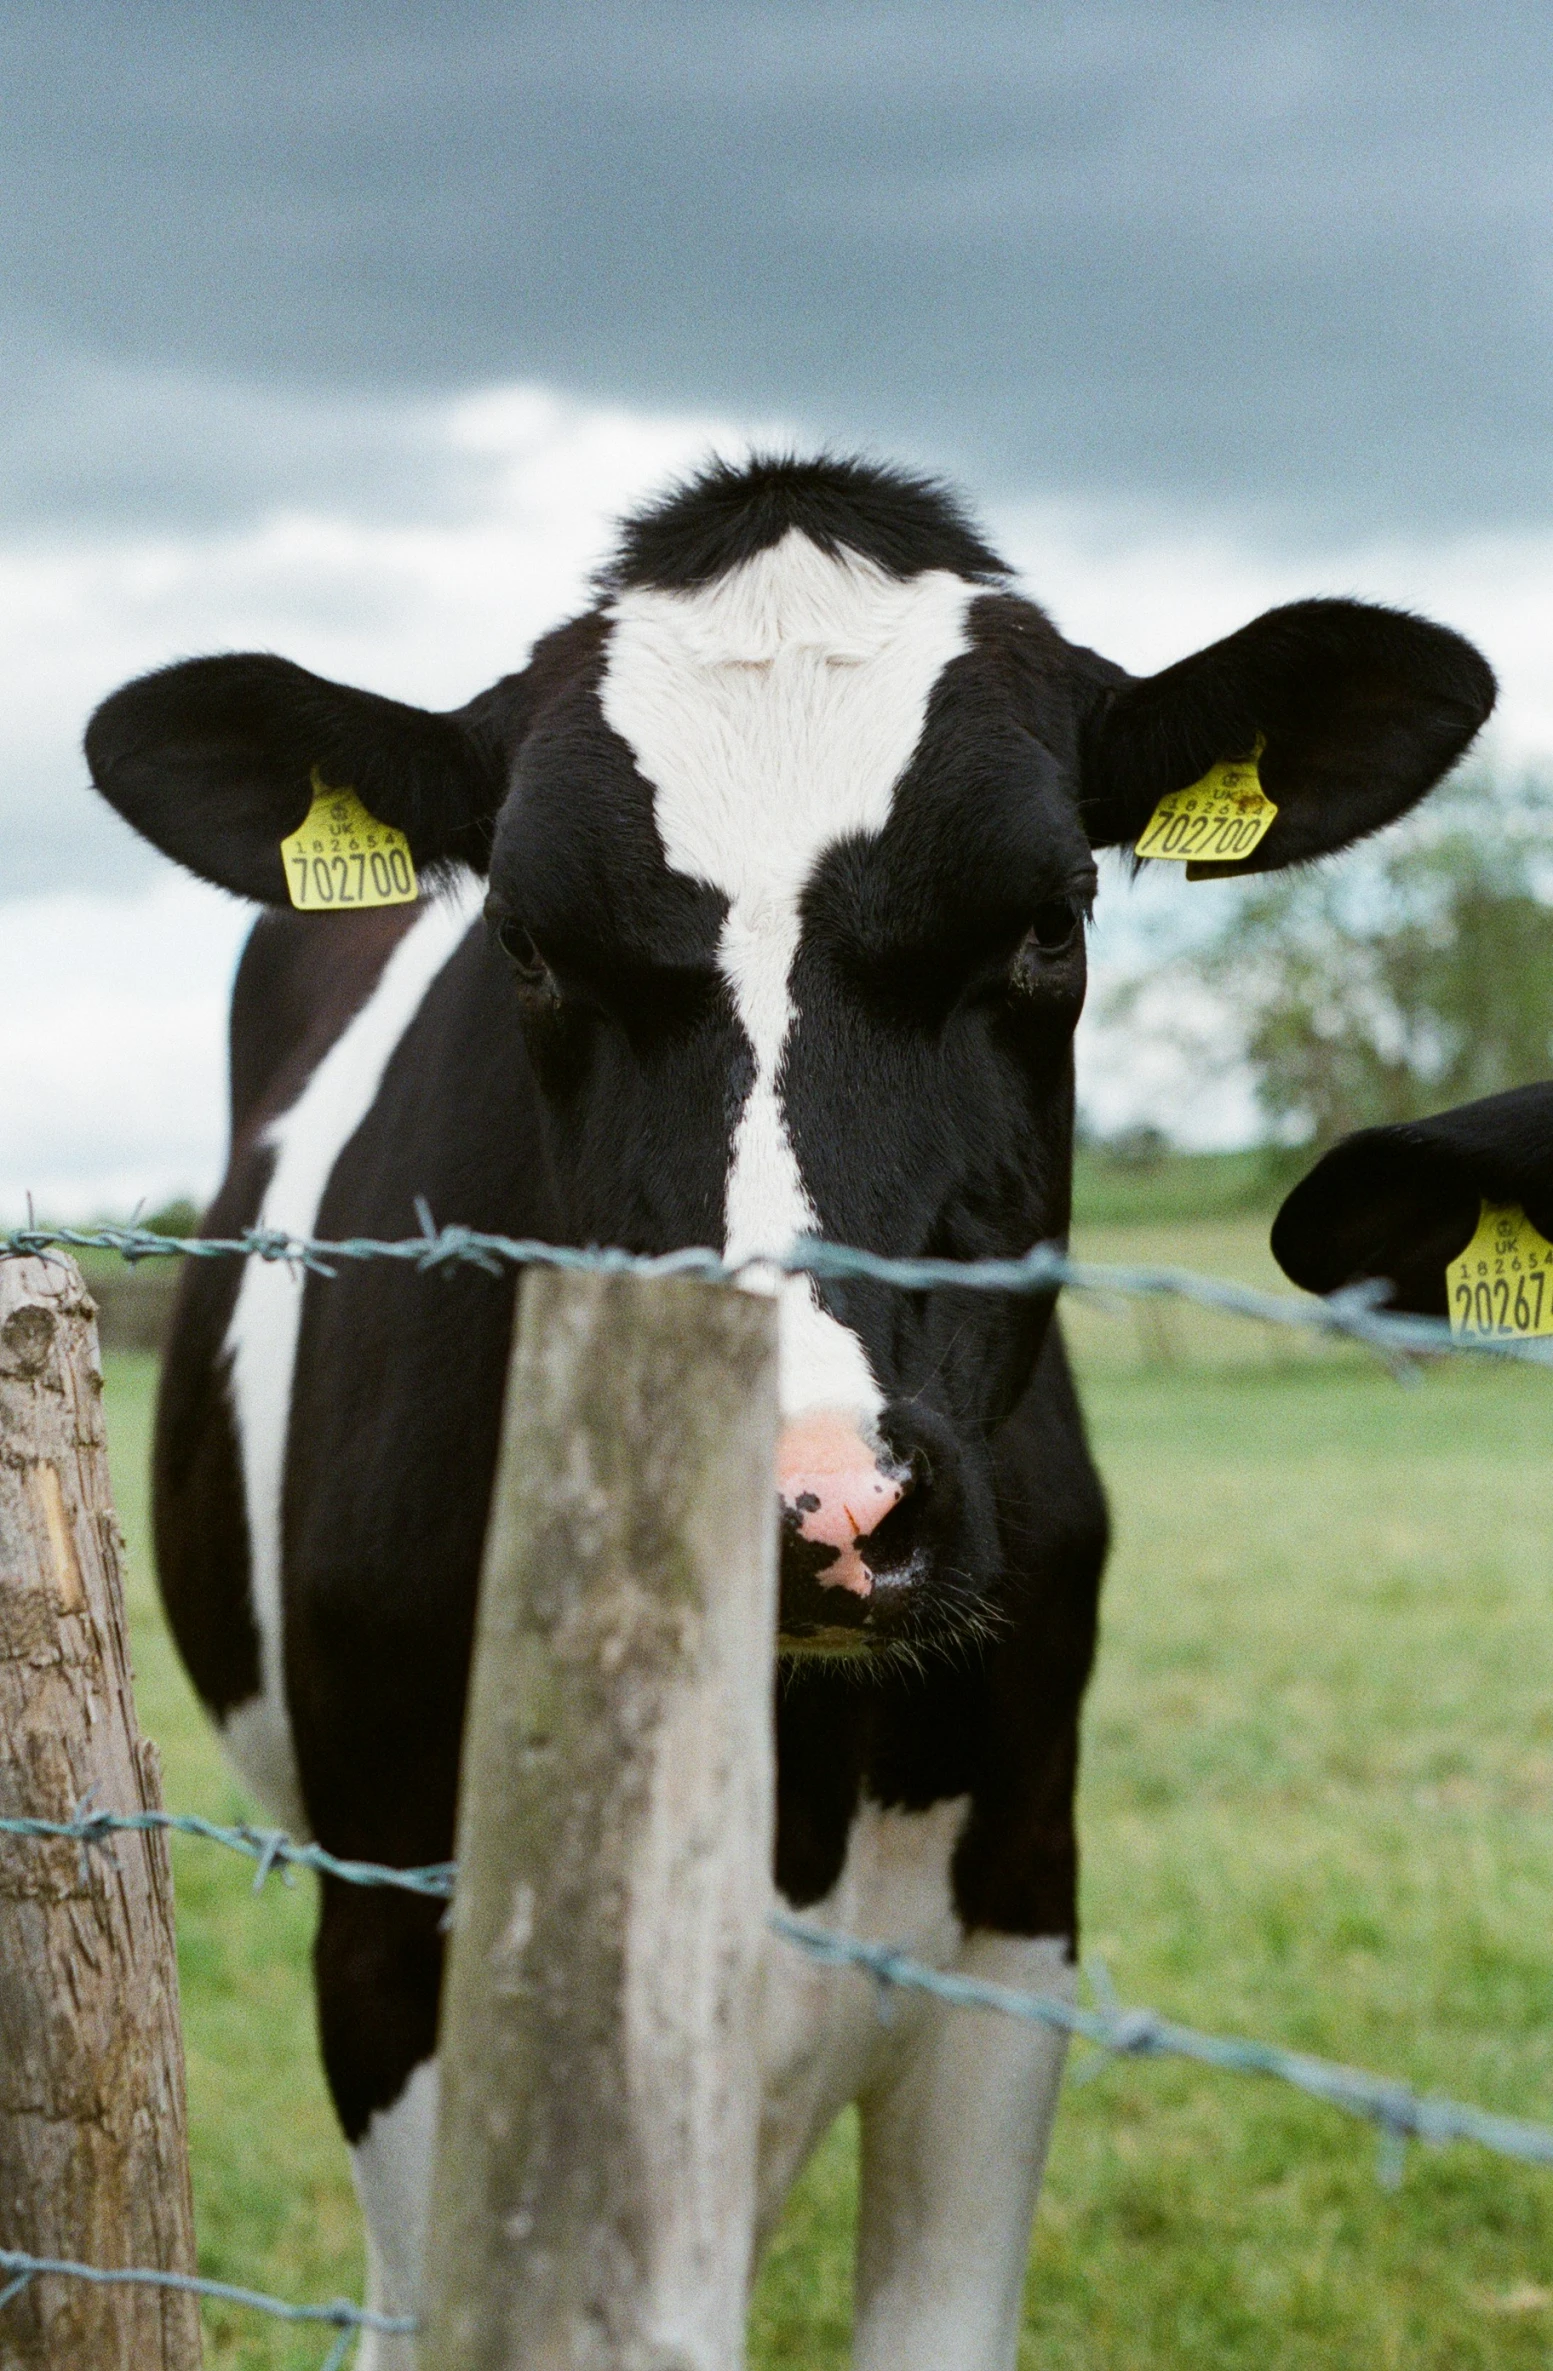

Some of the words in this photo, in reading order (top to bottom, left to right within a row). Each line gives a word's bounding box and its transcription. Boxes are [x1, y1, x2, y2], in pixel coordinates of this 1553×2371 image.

[329, 823, 354, 836] UK
[1142, 811, 1261, 854] 702700
[292, 848, 411, 903] 702700
[1495, 1238, 1518, 1254] UK
[1456, 1271, 1553, 1337] 20267
